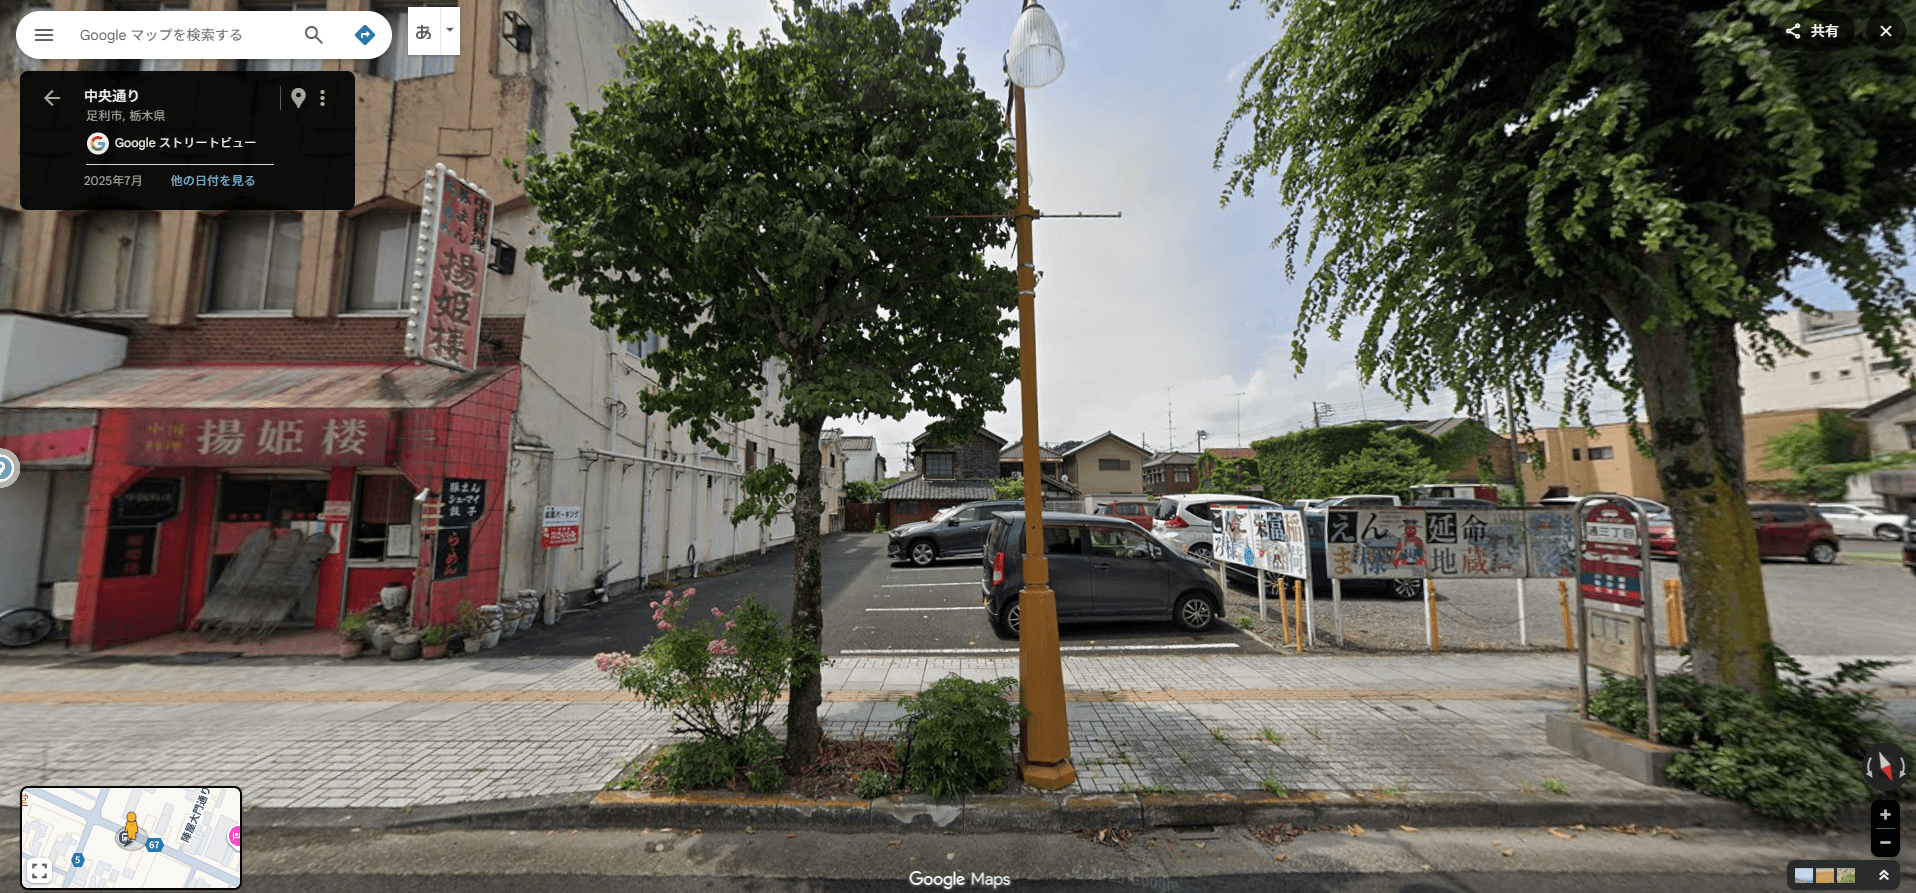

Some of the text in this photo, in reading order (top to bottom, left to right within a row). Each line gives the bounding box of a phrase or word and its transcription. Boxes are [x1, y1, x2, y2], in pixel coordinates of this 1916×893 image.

[197, 418, 368, 456] 揚姫楼
[447, 495, 481, 504] シューマイ
[450, 482, 481, 493] 豚まん
[1331, 512, 1388, 542] えん
[1428, 513, 1489, 542] 延命
[1431, 546, 1489, 576] 地蔵
